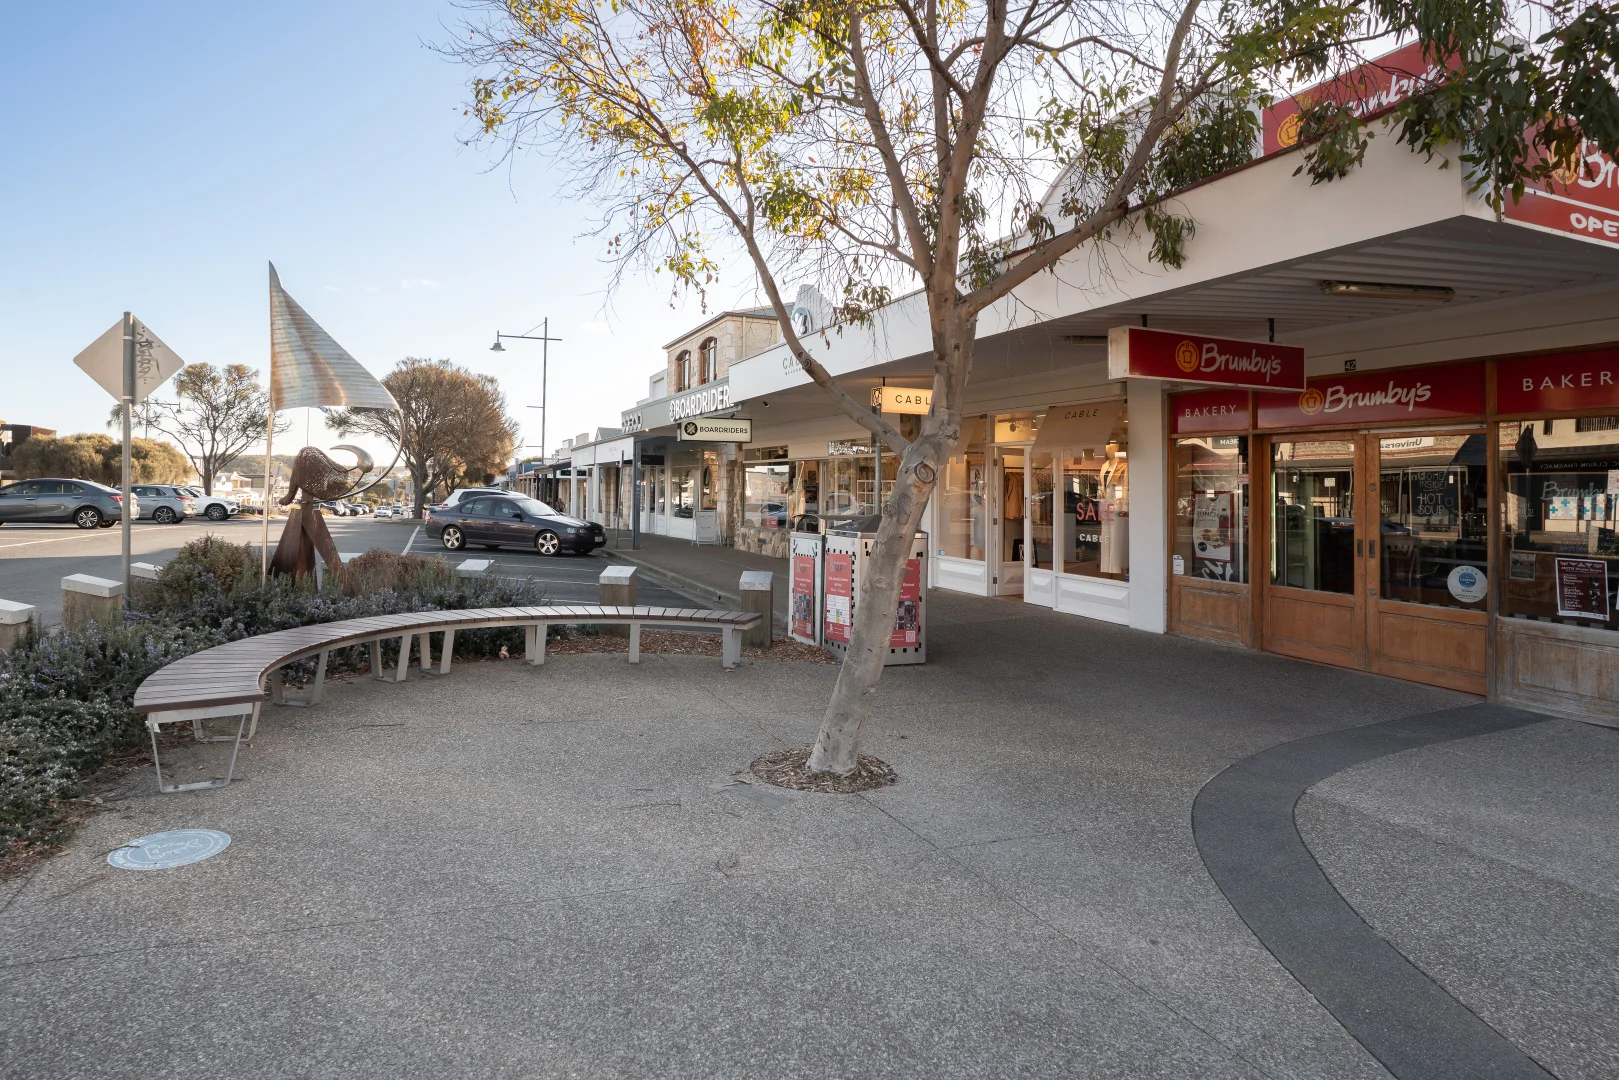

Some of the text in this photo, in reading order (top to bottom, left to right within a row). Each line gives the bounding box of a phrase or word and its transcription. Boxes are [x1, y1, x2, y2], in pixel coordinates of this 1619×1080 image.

[1200, 343, 1282, 383] Brumby's
[1345, 360, 1356, 370] 42
[1522, 371, 1614, 392] BAKER
[675, 385, 735, 420] BOARDRIDER
[895, 395, 931, 406] CABL
[1323, 381, 1432, 412] Brumby's
[1064, 408, 1099, 420] CABLE
[1185, 404, 1237, 418] BAKERY
[699, 426, 749, 434] BOARDRIDERS
[1417, 493, 1446, 505] HOT
[1076, 501, 1115, 522] SALE
[1417, 505, 1446, 516] SOUP
[1079, 533, 1110, 544] CABLE
